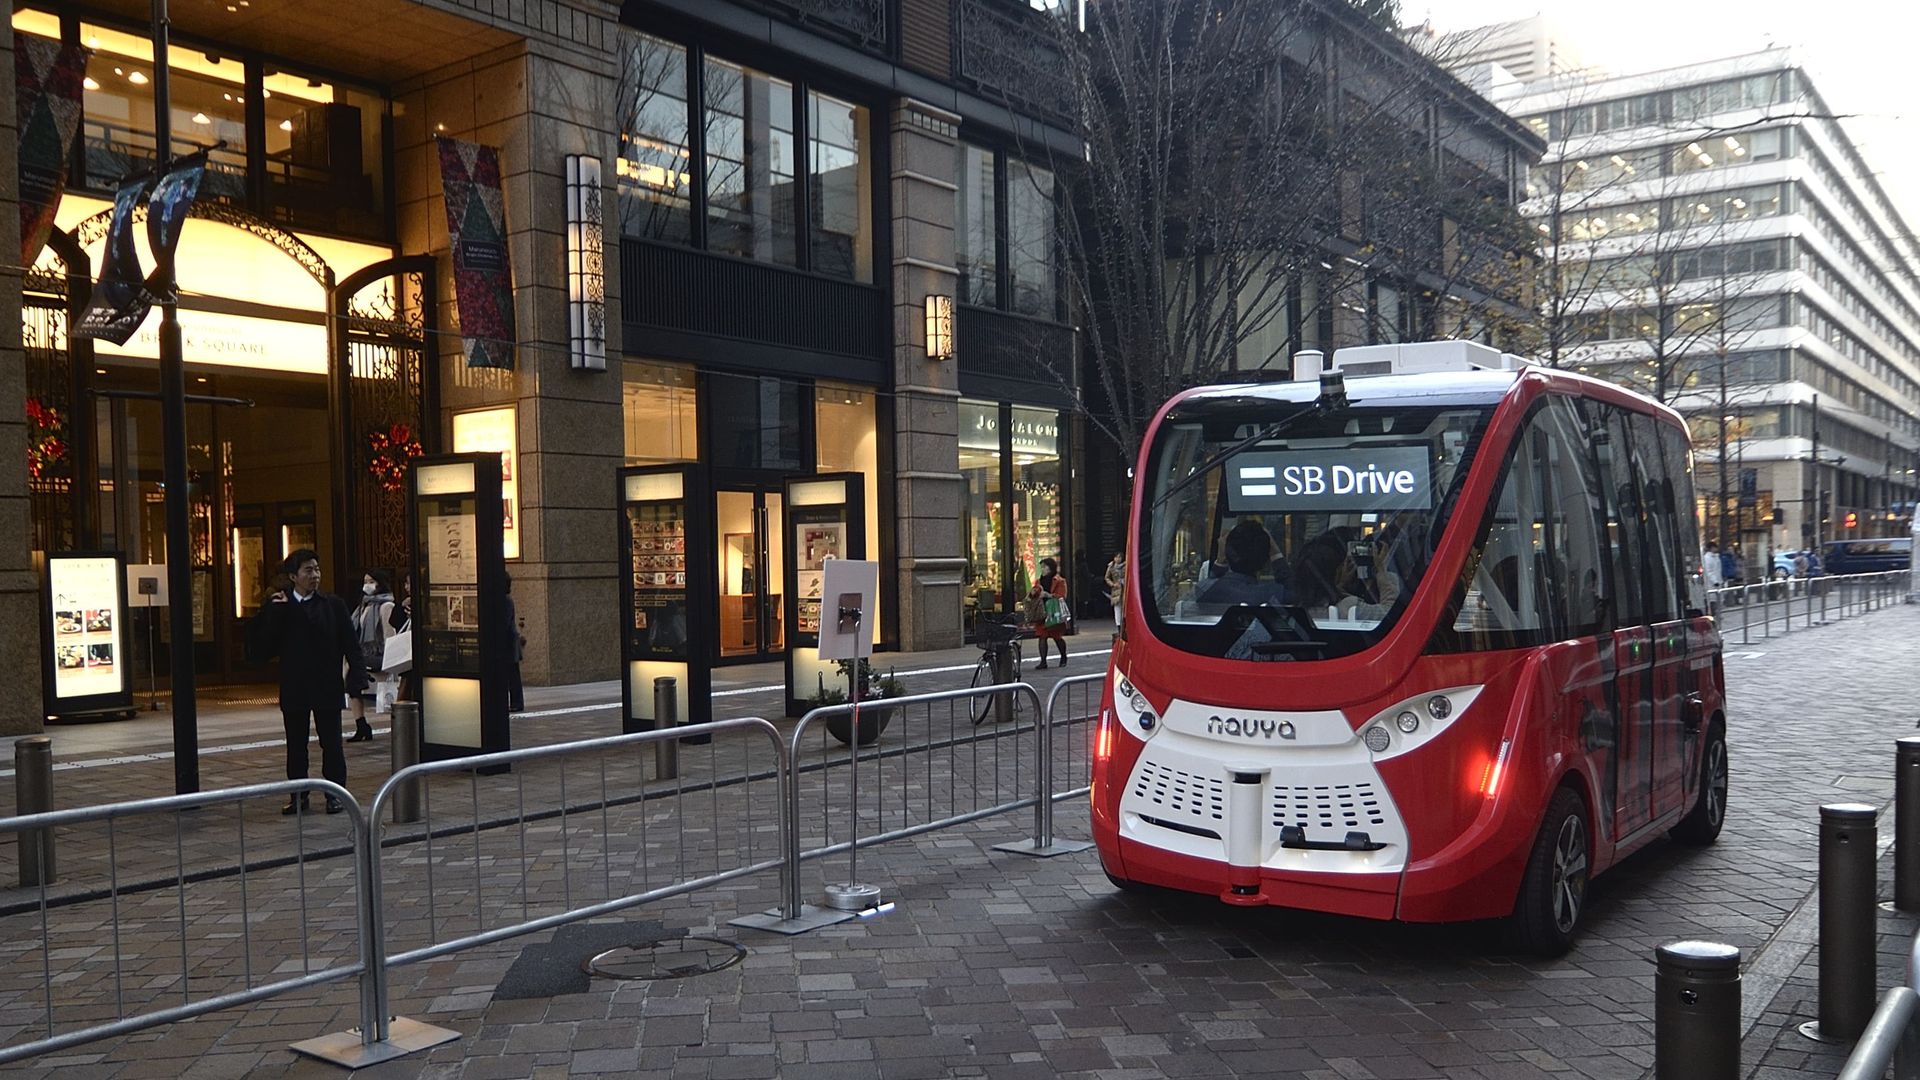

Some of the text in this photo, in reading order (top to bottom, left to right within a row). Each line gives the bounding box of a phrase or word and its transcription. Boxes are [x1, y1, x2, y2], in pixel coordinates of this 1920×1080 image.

[1011, 437, 1039, 446] ONDON
[1283, 464, 1415, 495] SB Drive
